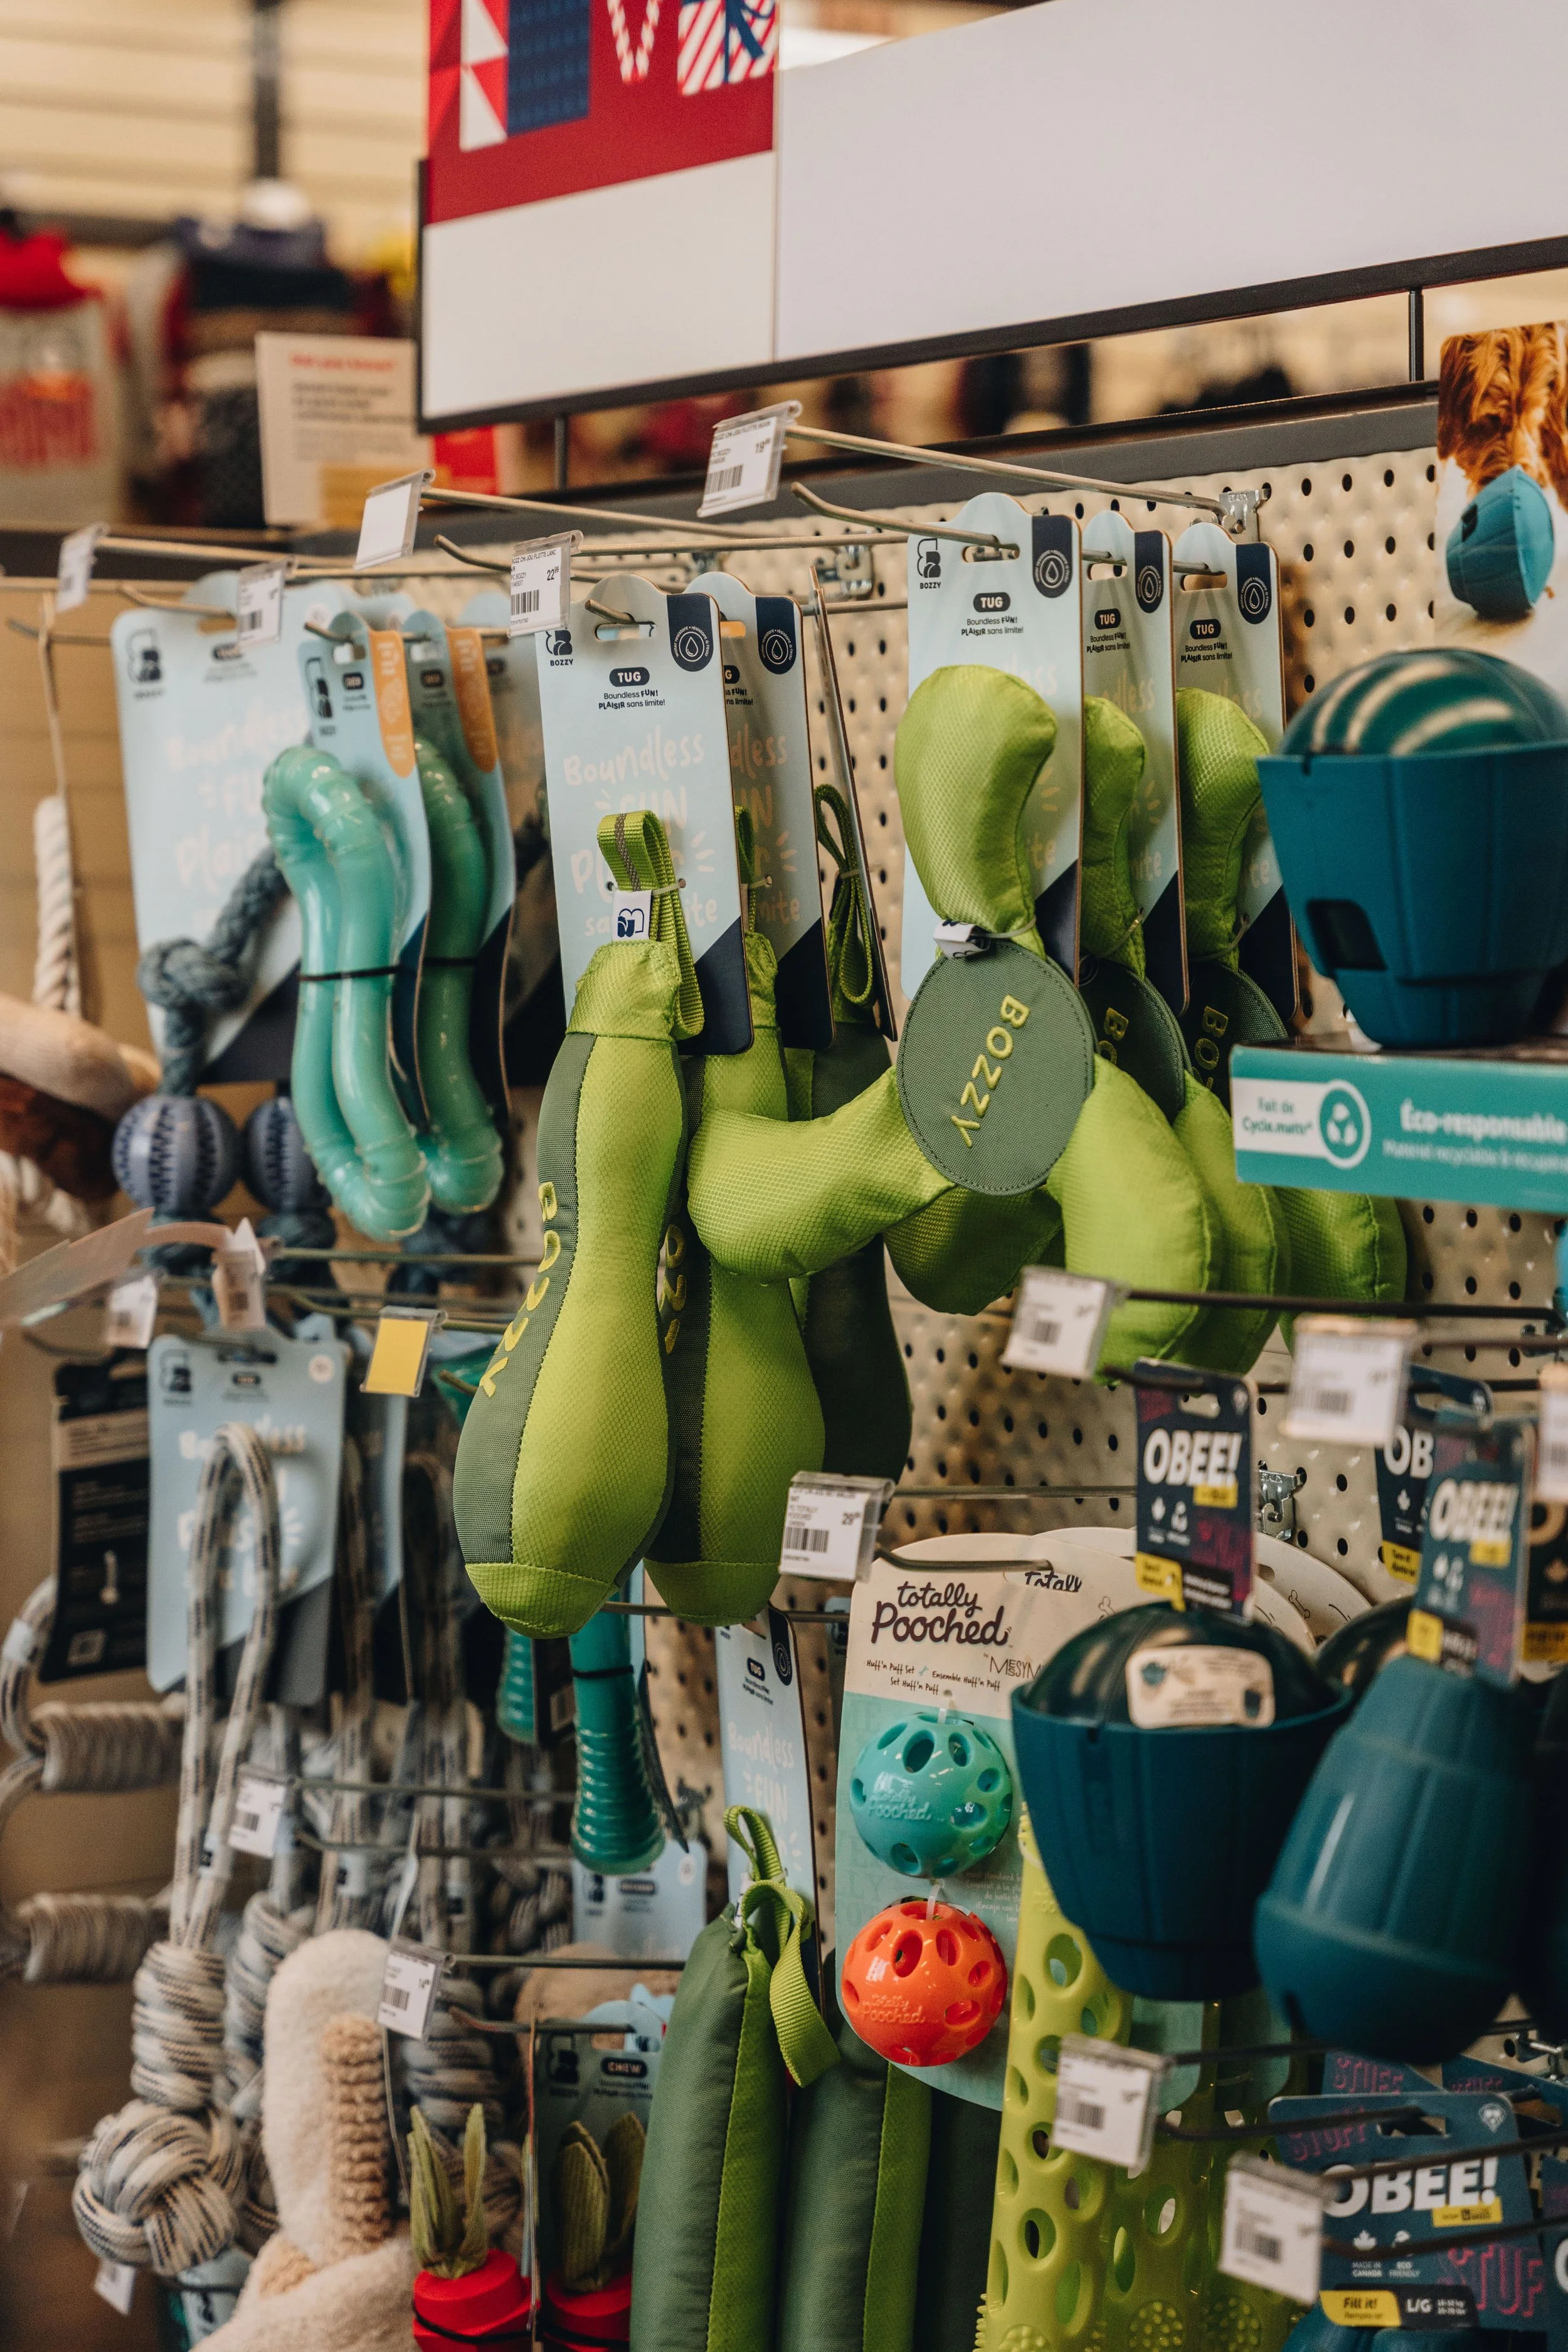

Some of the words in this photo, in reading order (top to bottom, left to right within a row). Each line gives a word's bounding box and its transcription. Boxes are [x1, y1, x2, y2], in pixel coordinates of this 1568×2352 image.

[980, 597, 1004, 608] TUG
[967, 617, 1000, 625] Boundless
[1099, 614, 1115, 625] TUG
[961, 628, 986, 636] PLAISIR
[1196, 624, 1214, 635] TUG
[1115, 632, 1126, 641] FUN!
[1086, 645, 1104, 654] PLAISIR
[1214, 642, 1227, 650] FUN!
[1180, 654, 1202, 663] PLAISIR
[618, 672, 641, 683] TUG
[604, 691, 640, 699] Boundless
[640, 689, 658, 697] FUN!
[732, 687, 747, 696] FUN!
[598, 701, 625, 709] PLAISIR
[645, 699, 665, 707] limite!
[563, 723, 705, 785] Boundless
[951, 994, 1030, 1147] BOZZY
[1143, 1428, 1242, 1491] OBEE!
[898, 1581, 983, 1618] totally
[871, 1601, 1011, 1646] Pooched
[867, 1660, 887, 1671] Huff'n
[889, 1663, 903, 1675] Puff
[905, 1665, 914, 1674] Set
[891, 1677, 899, 1686] Set
[902, 1680, 923, 1692] Huff'n
[925, 1683, 939, 1695] Puff
[932, 1670, 961, 1682] Ensemble
[963, 1676, 984, 1688] Huff'n
[987, 1679, 1000, 1692] Puff
[1323, 2156, 1499, 2218] OBEE!
[1396, 2261, 1412, 2270] ECO
[1352, 2269, 1383, 2279] CANADA
[1343, 2297, 1362, 2309] Fill
[1364, 2297, 1378, 2310] it!
[1406, 2299, 1433, 2314] L/G
